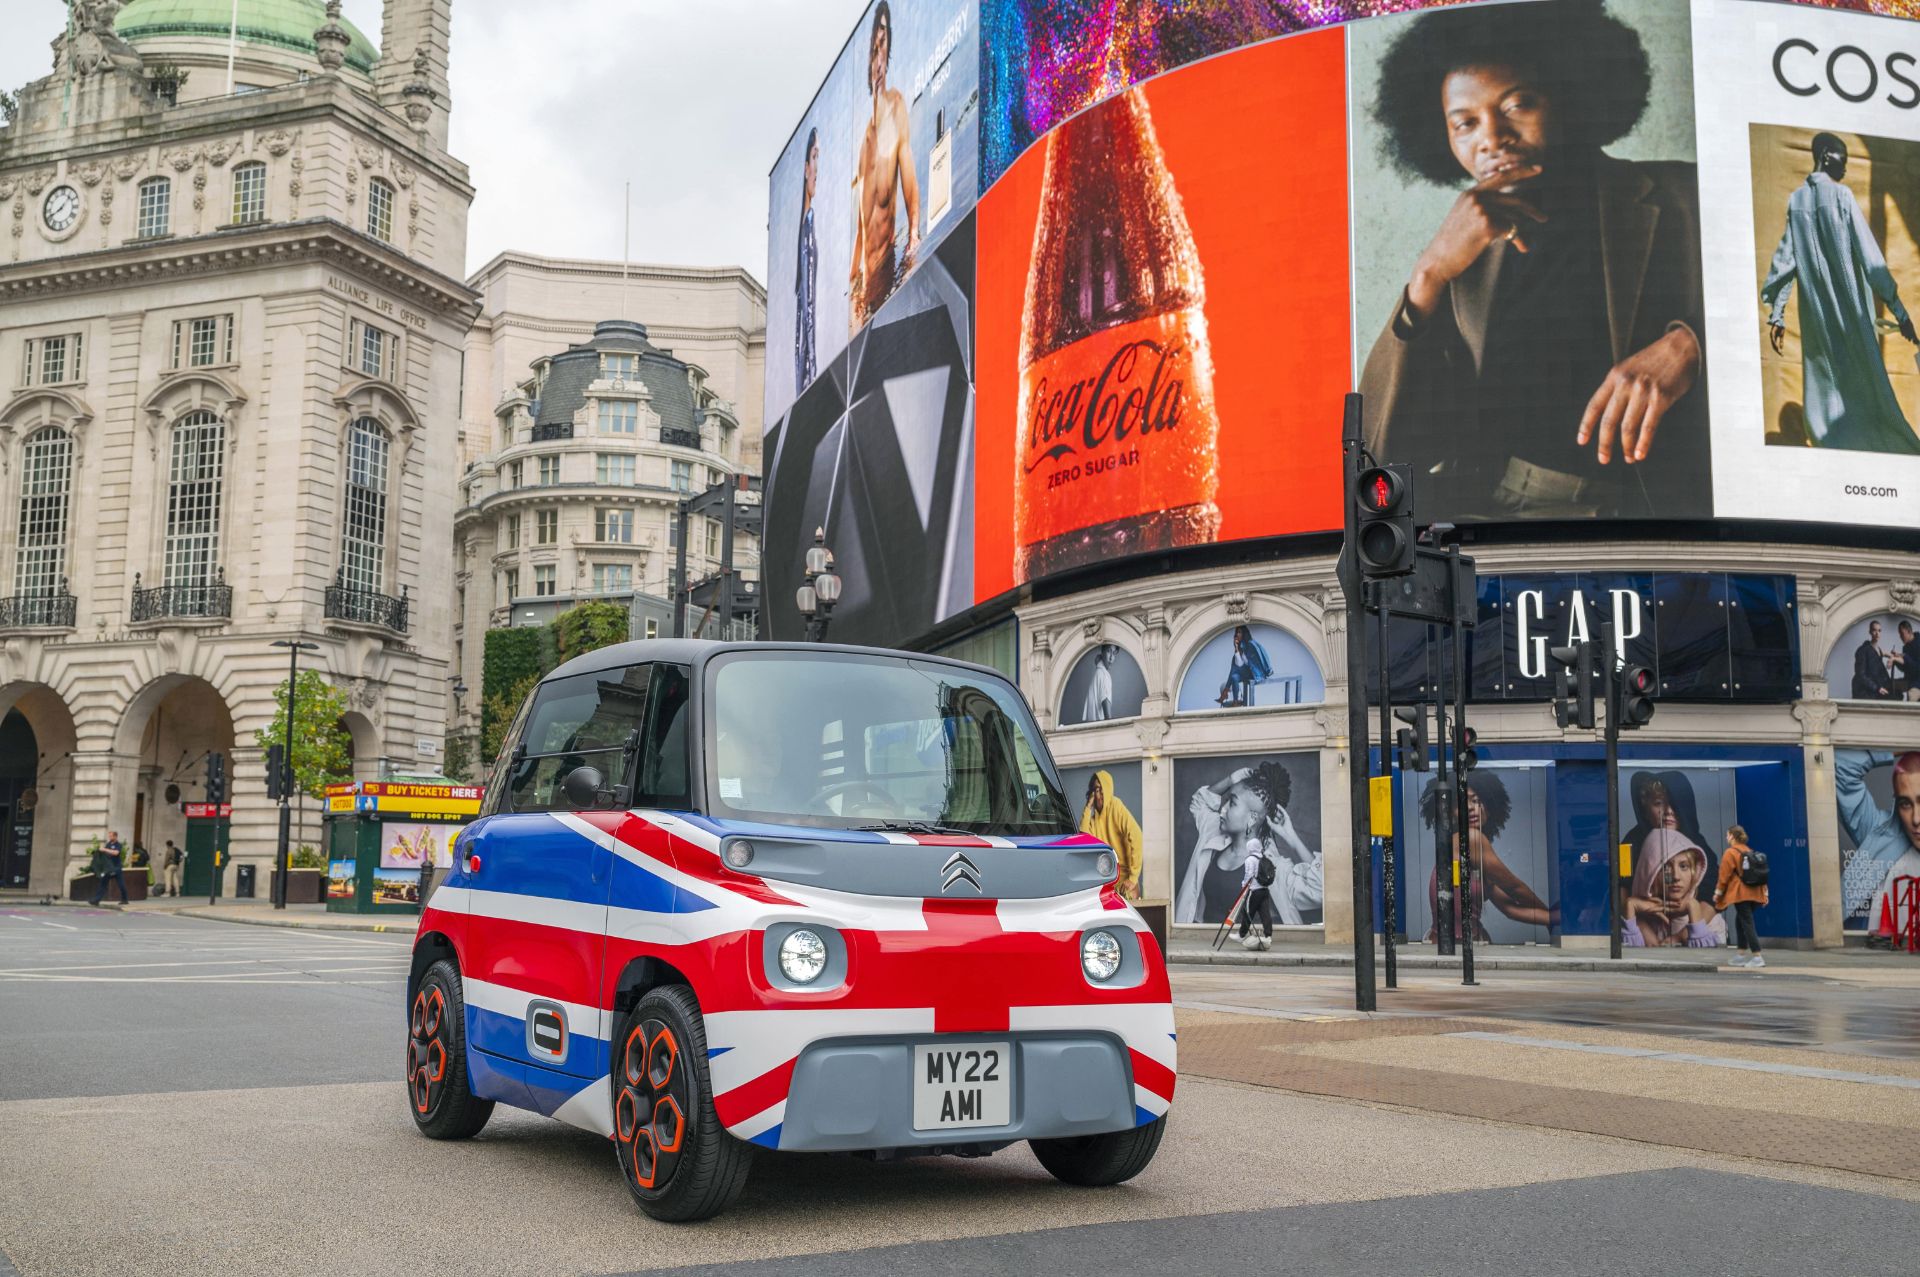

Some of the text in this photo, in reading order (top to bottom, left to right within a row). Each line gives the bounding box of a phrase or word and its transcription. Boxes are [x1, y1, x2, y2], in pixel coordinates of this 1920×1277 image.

[914, 3, 970, 99] BURBERRY
[931, 60, 951, 98] HERO
[1772, 38, 1920, 110] COS
[328, 276, 427, 330] ALLIANCE LIFE OFFICE
[1031, 336, 1184, 449] Coca-Cola
[1047, 449, 1140, 490] ZERO SUGAR
[1844, 484, 1898, 498] cos.com
[1517, 589, 1641, 678] GAP
[387, 784, 408, 796] BUY
[409, 785, 450, 797] TICKETS
[451, 787, 477, 799] HERE
[411, 812, 462, 821] HOT DOG SPOT
[1843, 850, 1869, 859] YOUR
[1844, 860, 1883, 870] CLOSEST
[1844, 870, 1885, 880] STORE IS
[1846, 900, 1869, 909] LONG
[927, 1050, 999, 1084] MY22
[940, 1089, 982, 1122] AMI
